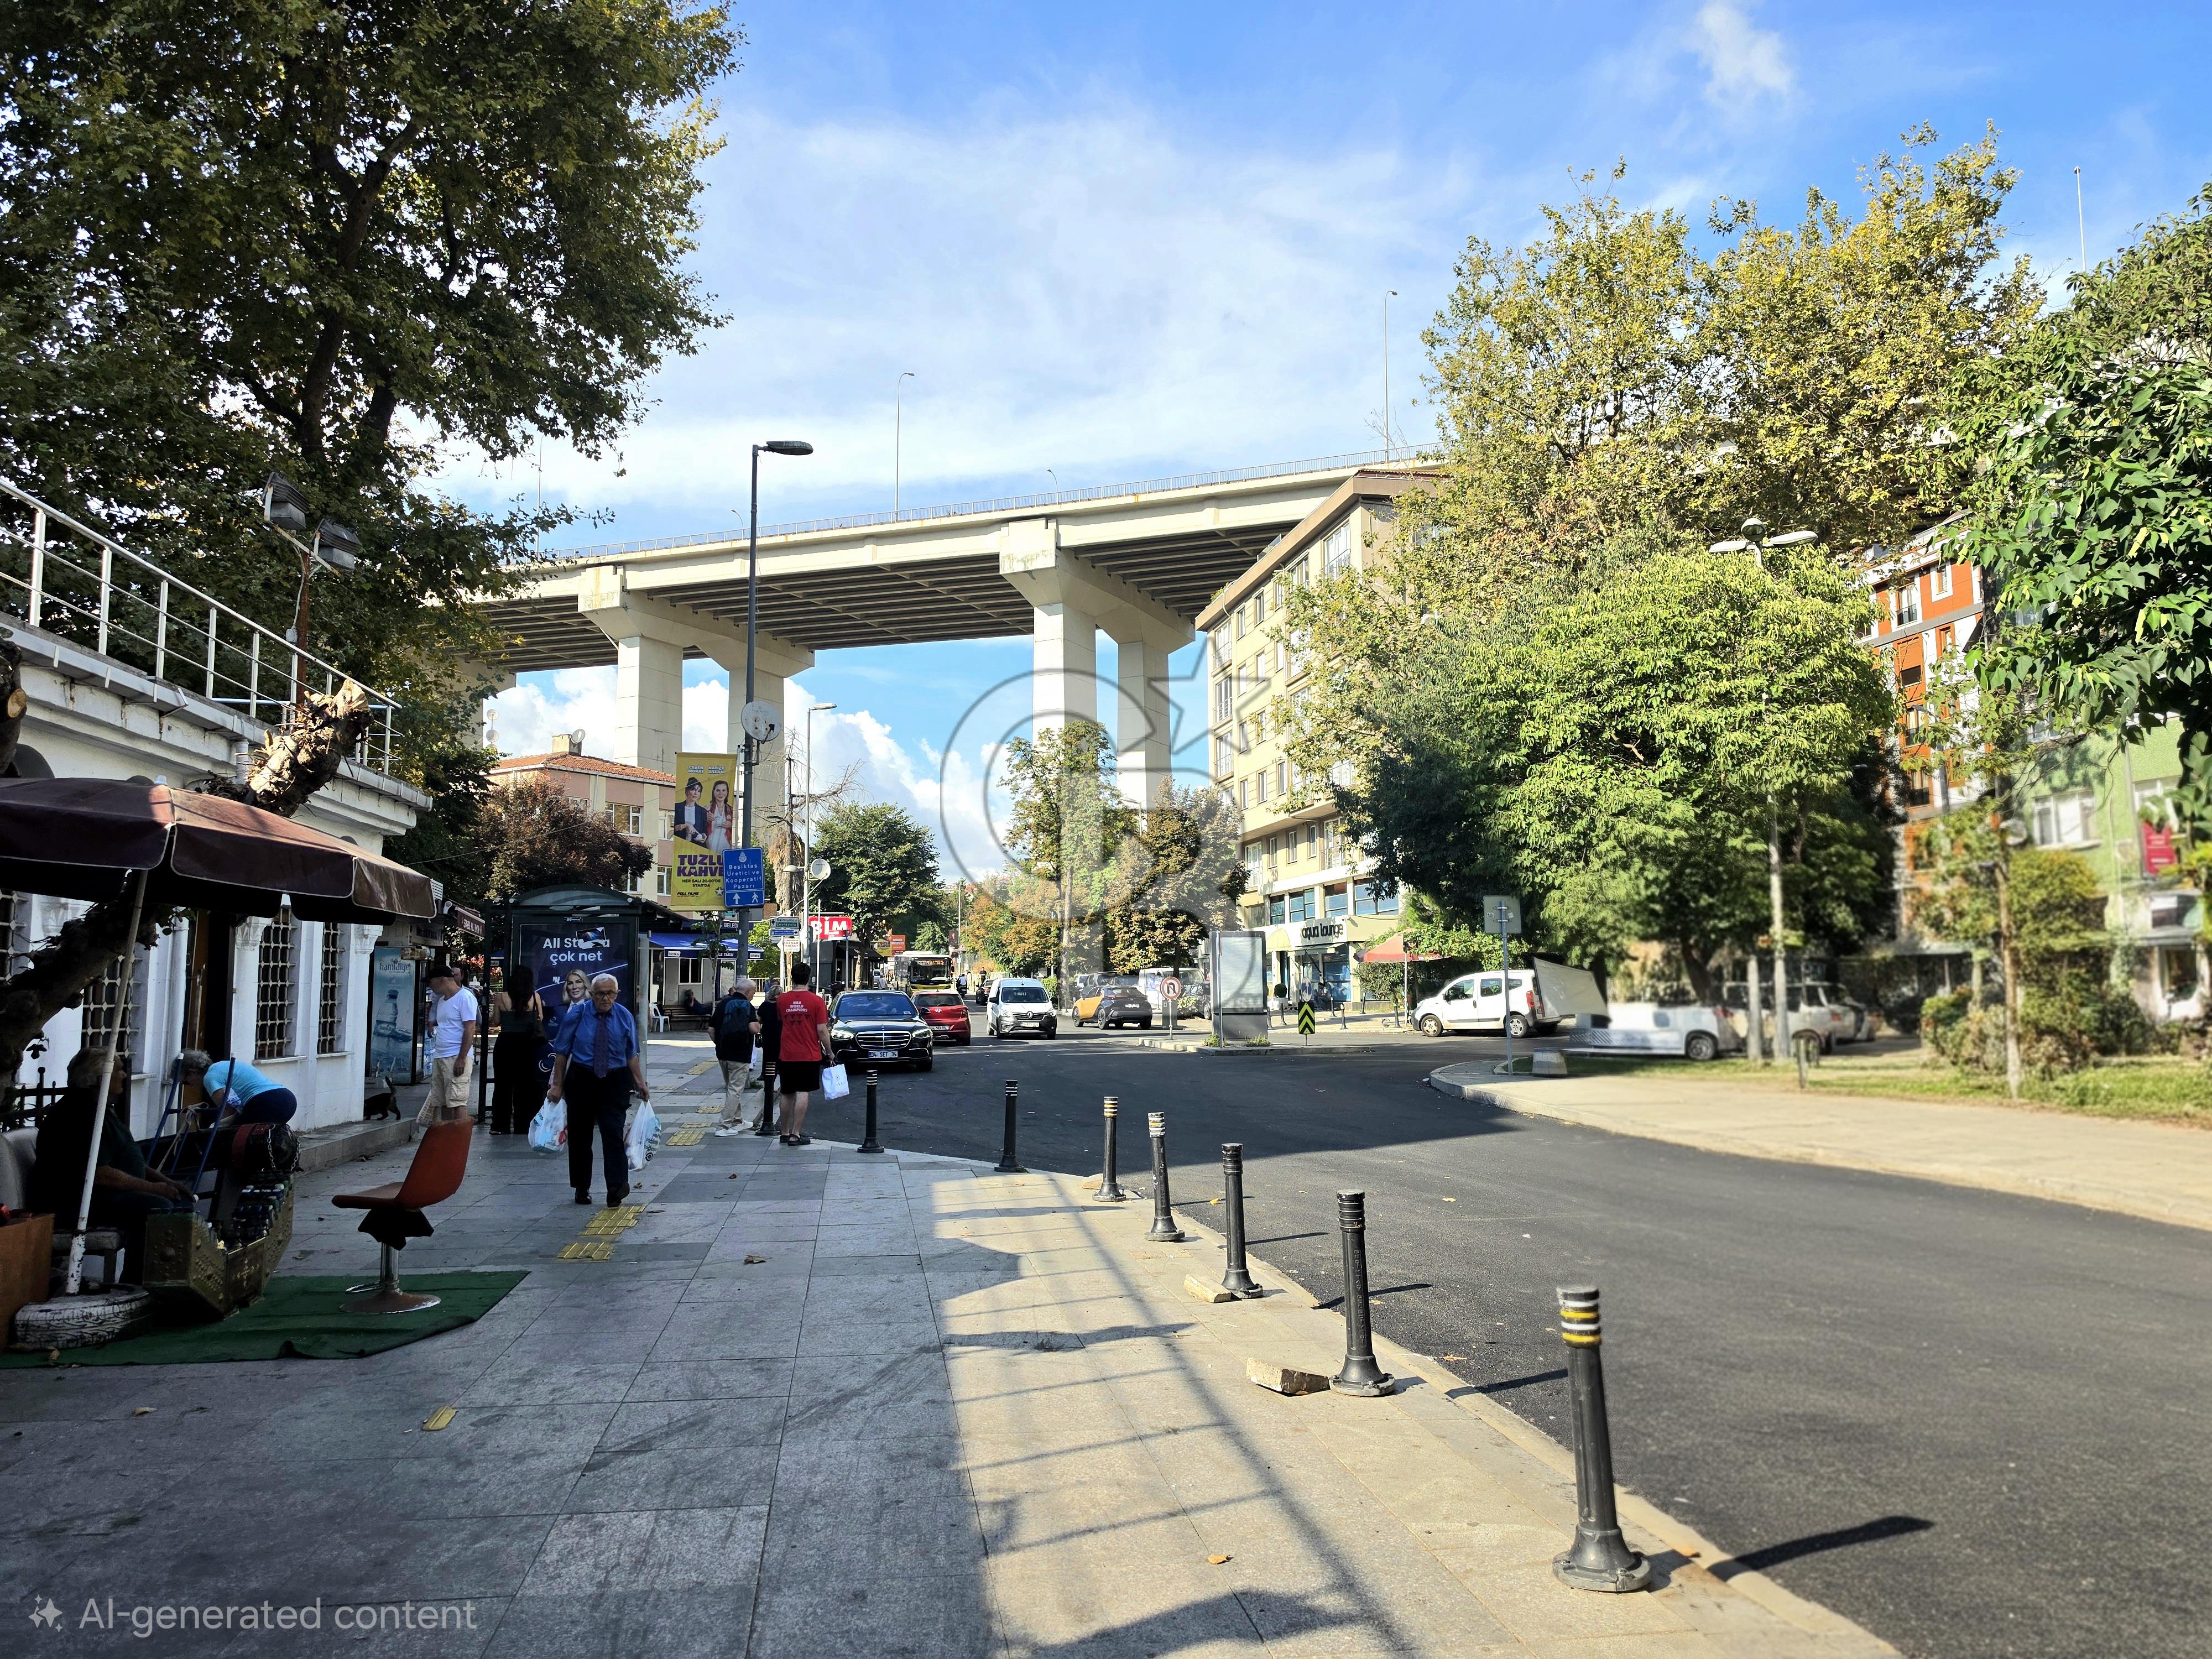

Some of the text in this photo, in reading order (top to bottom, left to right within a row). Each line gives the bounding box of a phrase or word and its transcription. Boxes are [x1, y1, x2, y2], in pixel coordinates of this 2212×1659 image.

[678, 854, 723, 865] TUZLU
[677, 867, 724, 877] KAHVE
[1302, 924, 1344, 940] aqua lounge
[543, 938, 560, 948] All
[550, 951, 602, 966] çok net
